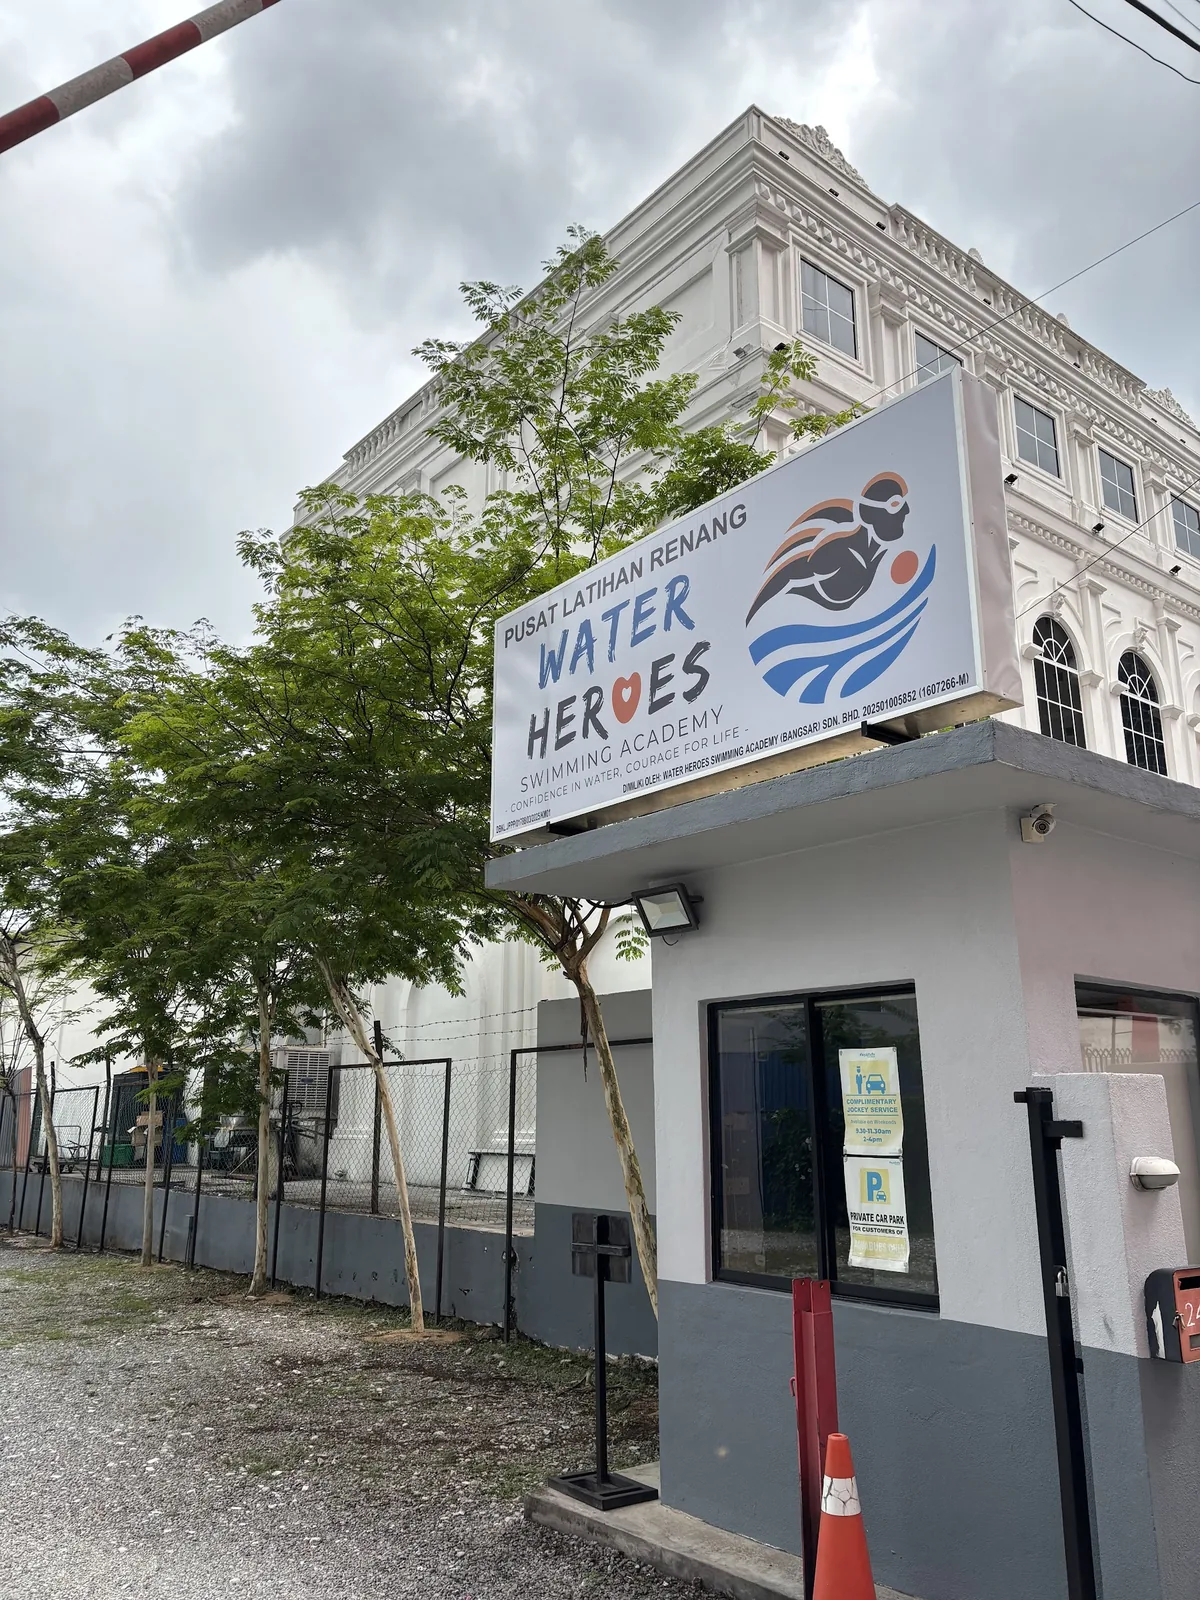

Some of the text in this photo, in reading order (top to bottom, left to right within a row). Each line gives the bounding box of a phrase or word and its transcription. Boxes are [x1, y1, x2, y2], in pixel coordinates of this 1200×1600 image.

[504, 503, 747, 648] PUSAT LATIHAN RENANG
[538, 574, 696, 690] WATER
[527, 640, 711, 760] HEROES
[645, 771, 662, 786] OLEH:
[663, 767, 684, 781] WATER
[684, 758, 710, 773] HEROES
[710, 747, 744, 765] SWIMMING
[745, 735, 779, 753] ACADEMY
[780, 721, 820, 743] (BANGSAR)
[822, 715, 840, 730] SDN.
[842, 710, 860, 724] BHD.
[862, 689, 916, 717] 202501005852
[918, 672, 969, 699] (1607266-M)
[510, 726, 740, 813] CONFIDENCE IN WATER, COURAGE FOR LIFE
[520, 705, 724, 793] SWIMMING ACADEMY
[850, 1211, 905, 1225] PRIVATE CAR PARK
[861, 1226, 896, 1235] CUSTOMERS
[866, 1171, 883, 1202] P
